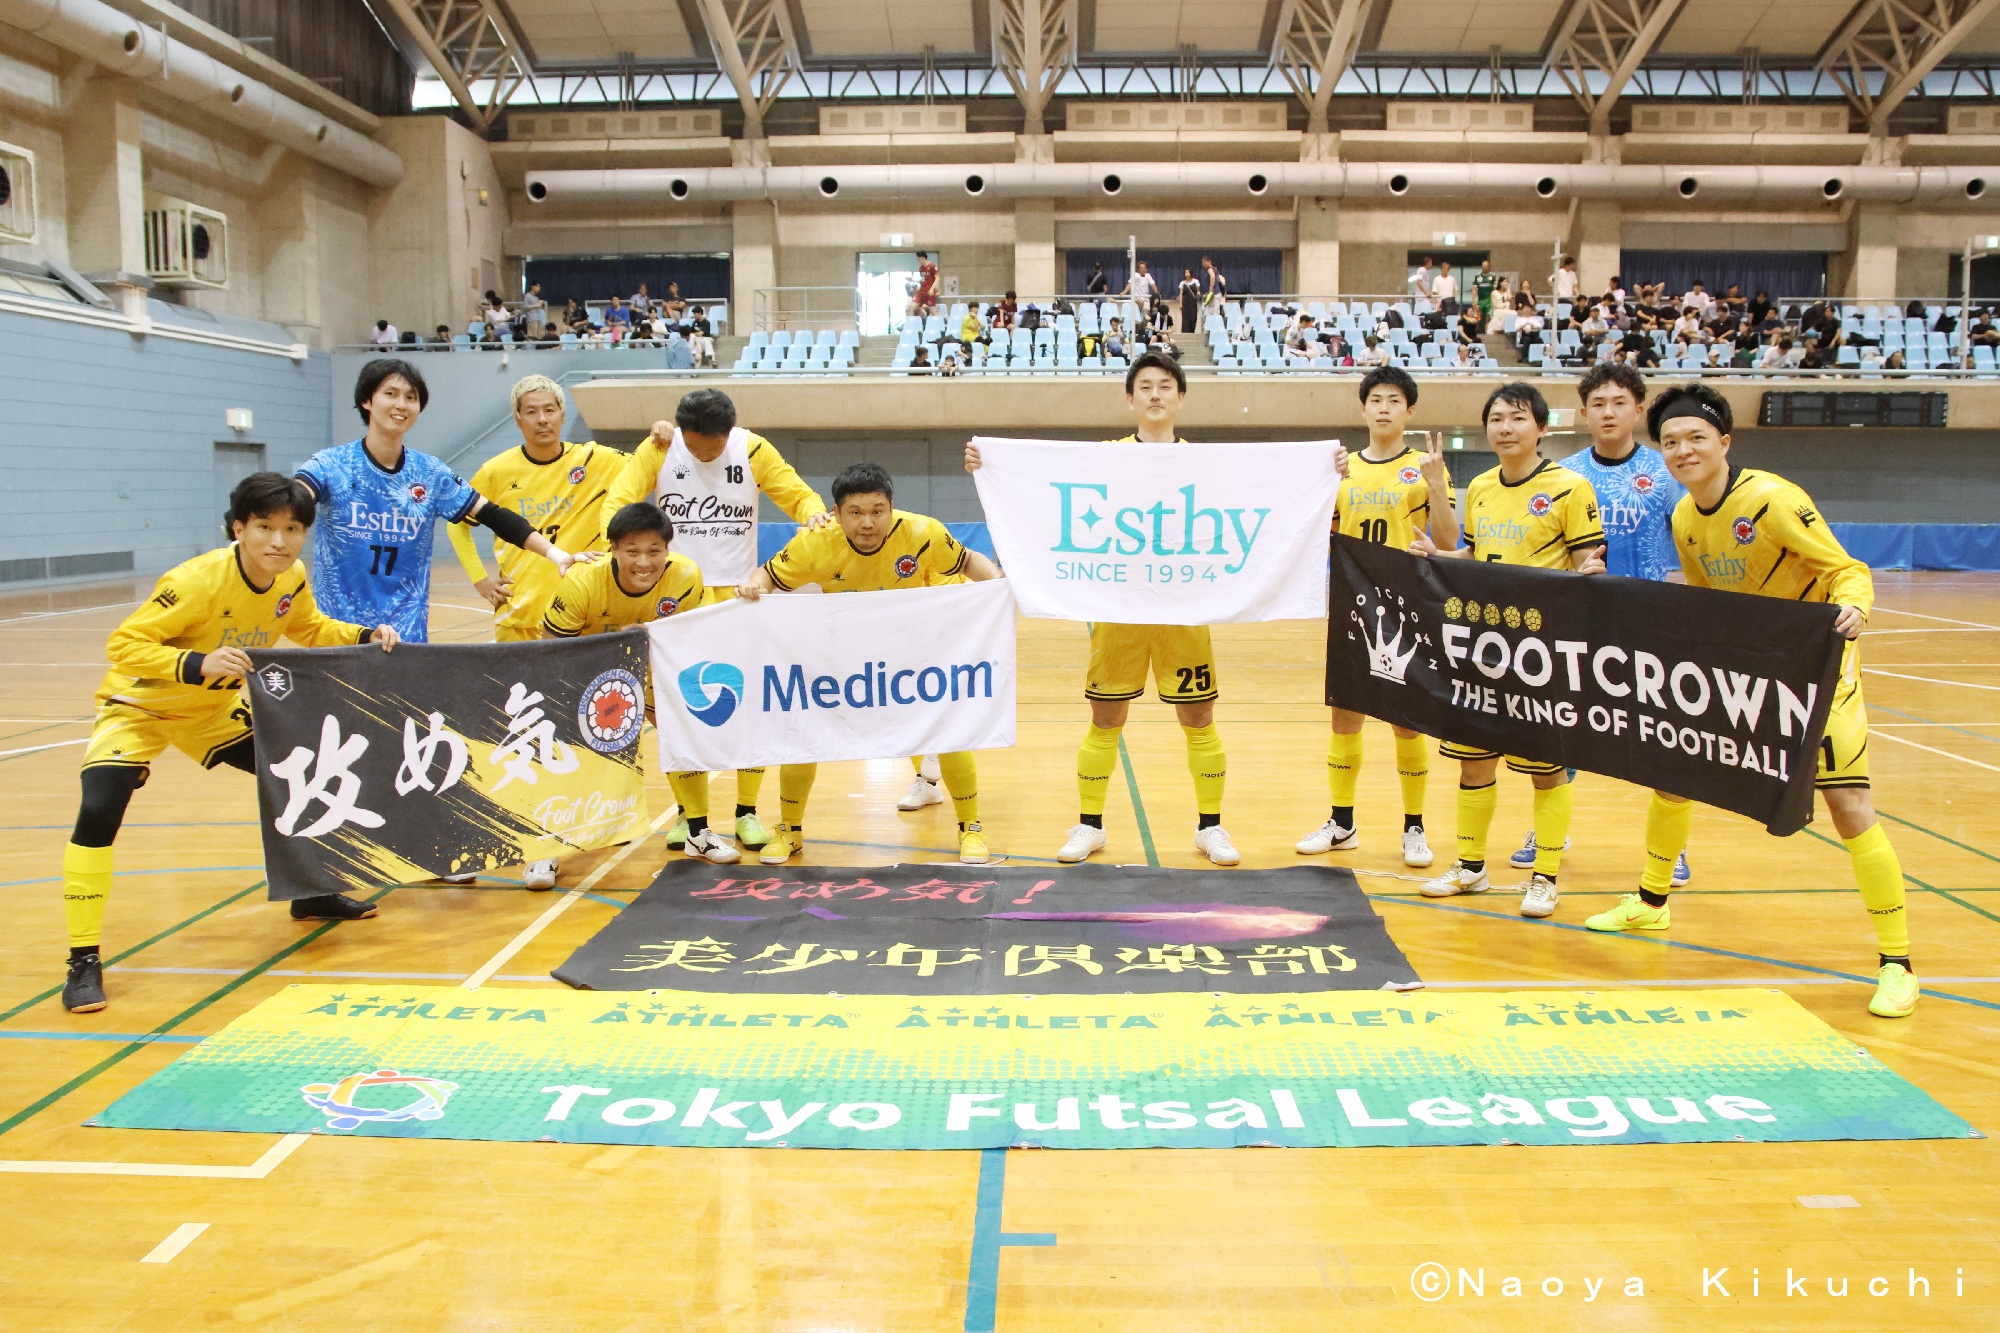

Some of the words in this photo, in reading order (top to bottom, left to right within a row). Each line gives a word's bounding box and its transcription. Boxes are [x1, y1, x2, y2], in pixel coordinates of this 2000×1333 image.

[725, 465, 744, 484] 18
[659, 493, 698, 519] Foot
[699, 495, 754, 520] Crown
[1349, 487, 1403, 510] Esthy
[347, 501, 427, 540] Esthy
[1050, 481, 1271, 575] Esthy
[1600, 499, 1649, 533] thy
[348, 530, 373, 540] SINCE
[1359, 518, 1387, 545] 10
[1476, 516, 1531, 544] Esthy
[1602, 528, 1626, 536] 994
[1055, 562, 1127, 583] SINCE
[1145, 564, 1217, 583] 1994
[265, 671, 287, 691] 美
[763, 661, 993, 712] Medicom
[1176, 664, 1212, 692] 25
[1441, 623, 1818, 745] FOOTCROWN
[1451, 679, 1498, 714] THE
[1505, 693, 1578, 727] KING
[1588, 705, 1628, 736] OF
[1638, 714, 1789, 783] FOOTBALL
[269, 682, 580, 838] 攻め気
[299, 1001, 547, 1023] ATHLETA
[589, 1009, 850, 1029] ATHLETA
[895, 1013, 1158, 1030] ATHLETA
[540, 1083, 903, 1142] Tokyo
[945, 1088, 1306, 1132] Futsal
[1336, 1088, 1777, 1138] League
